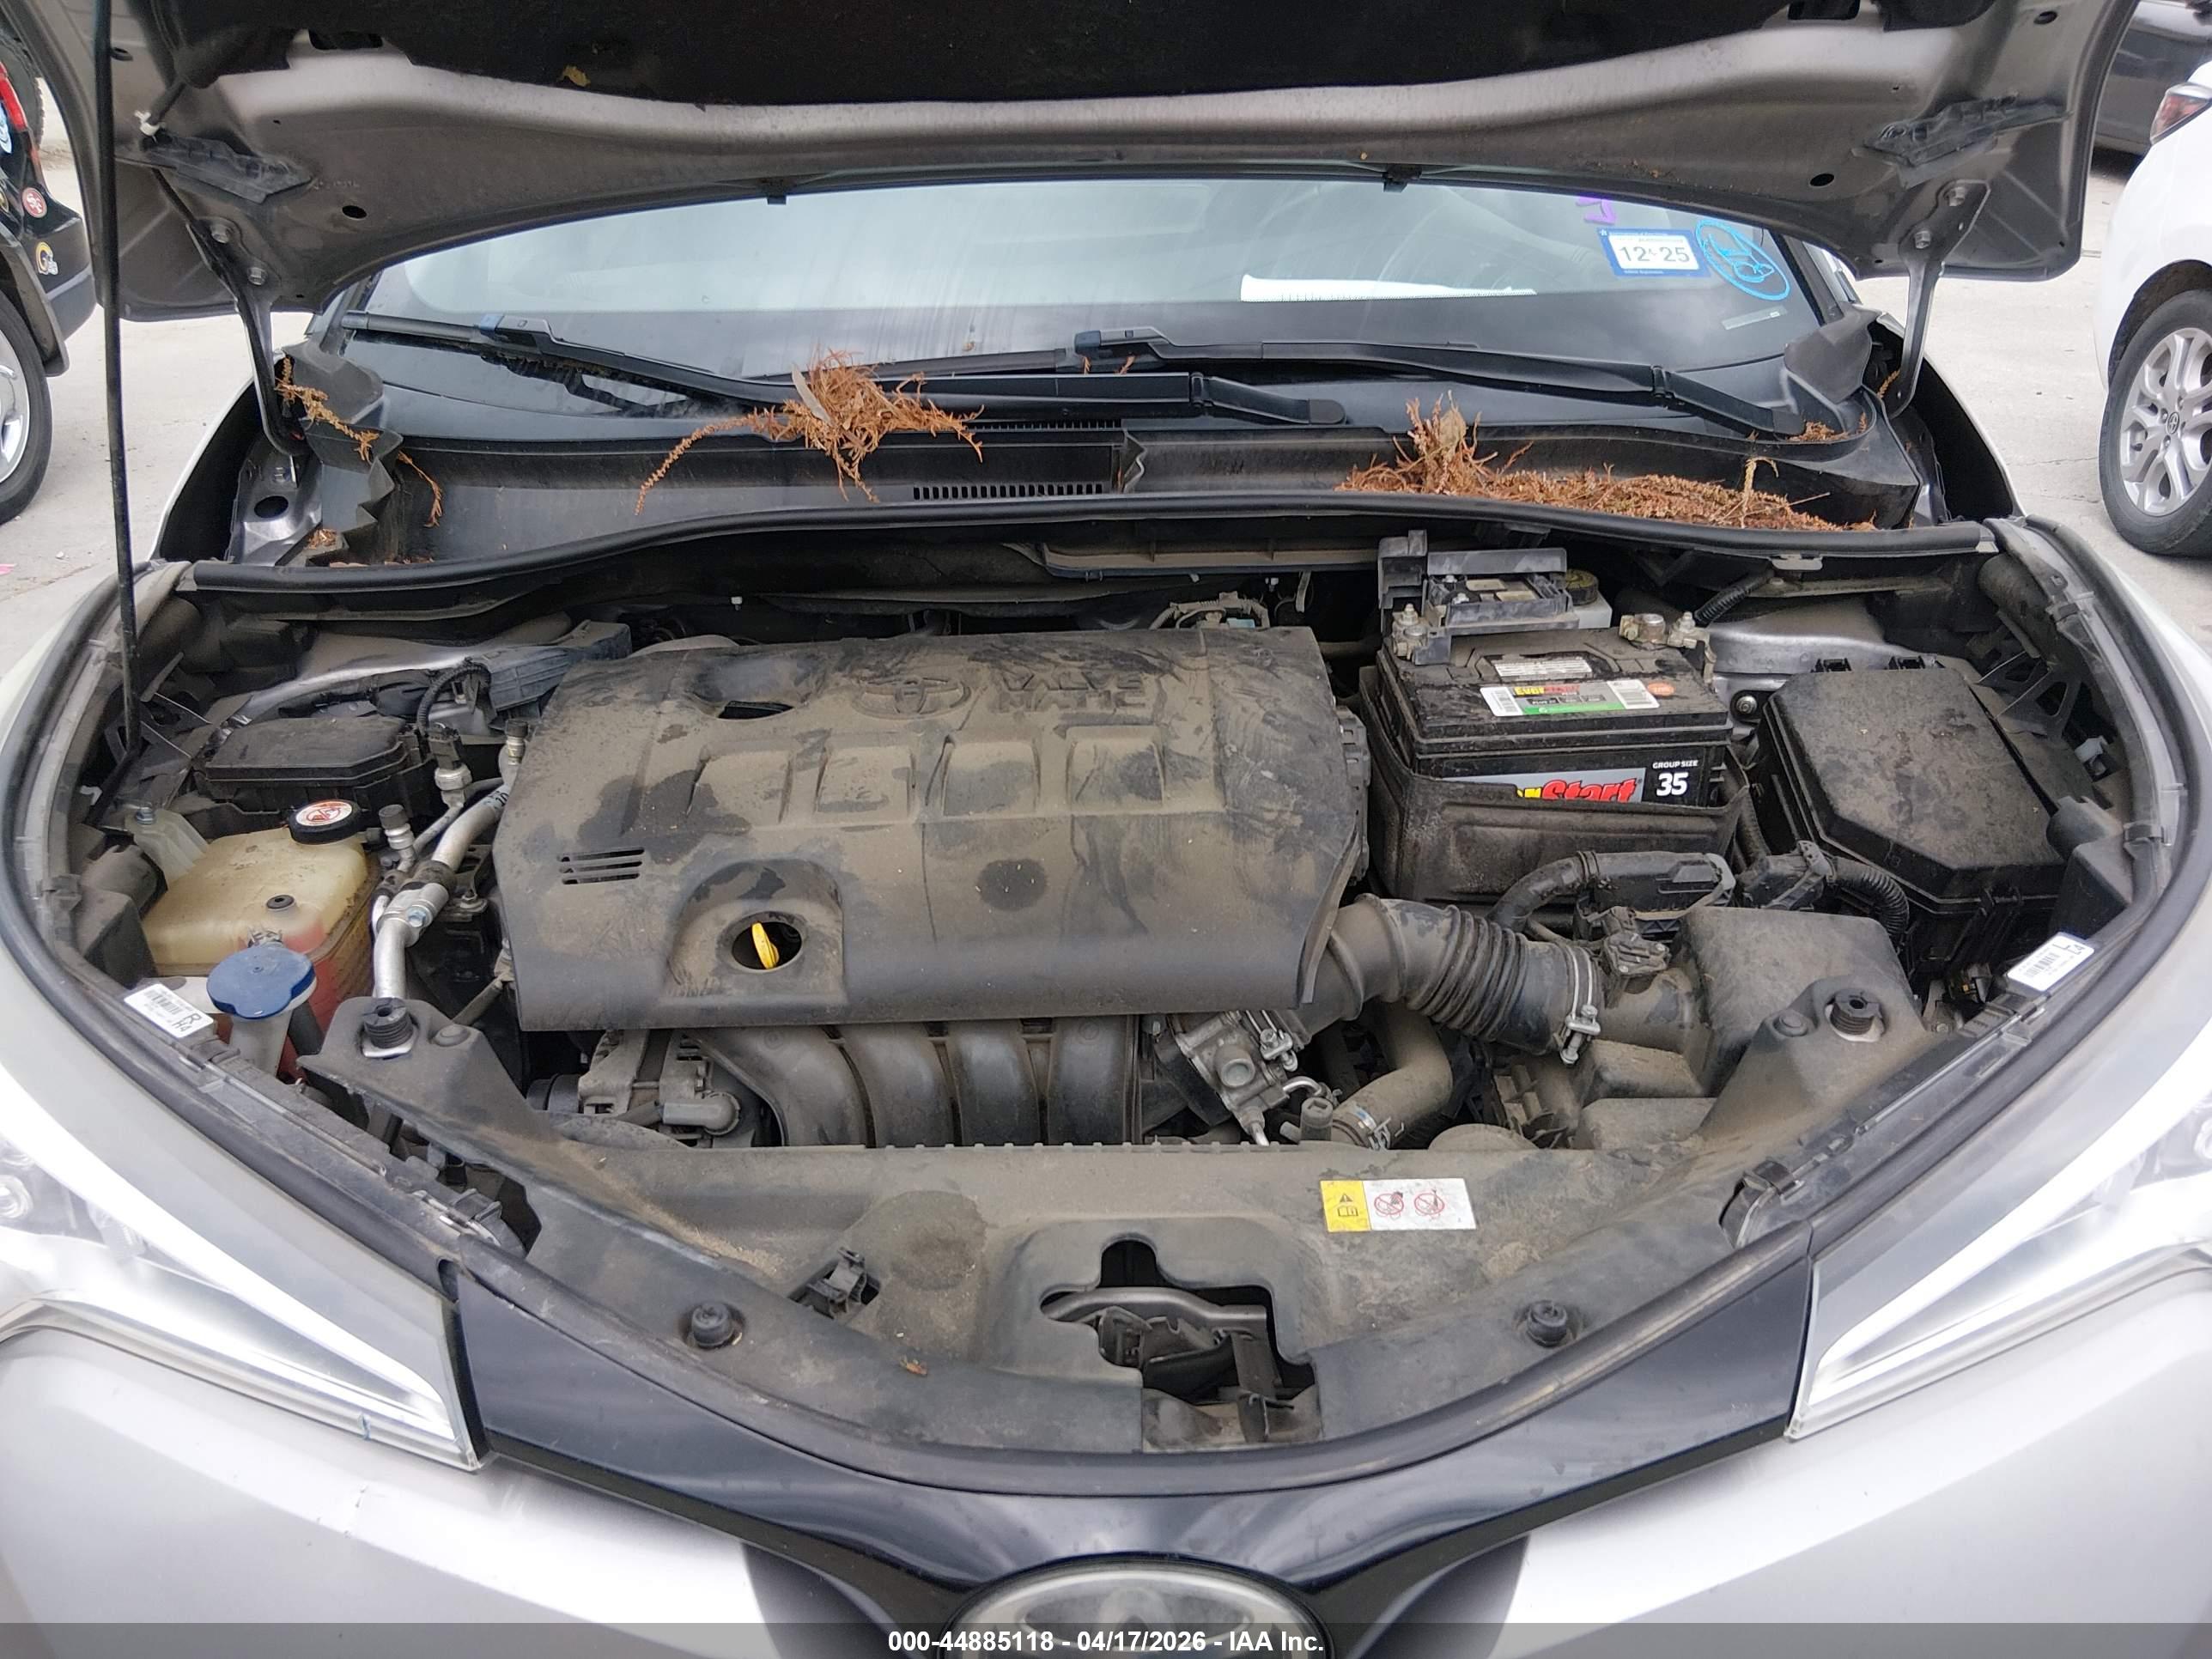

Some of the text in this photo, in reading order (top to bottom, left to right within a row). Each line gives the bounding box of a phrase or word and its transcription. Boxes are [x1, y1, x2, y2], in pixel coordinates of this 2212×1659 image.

[1652, 759, 1698, 769] GROUP SIZE
[1656, 772, 1689, 796] 35
[184, 1013, 203, 1025] R
